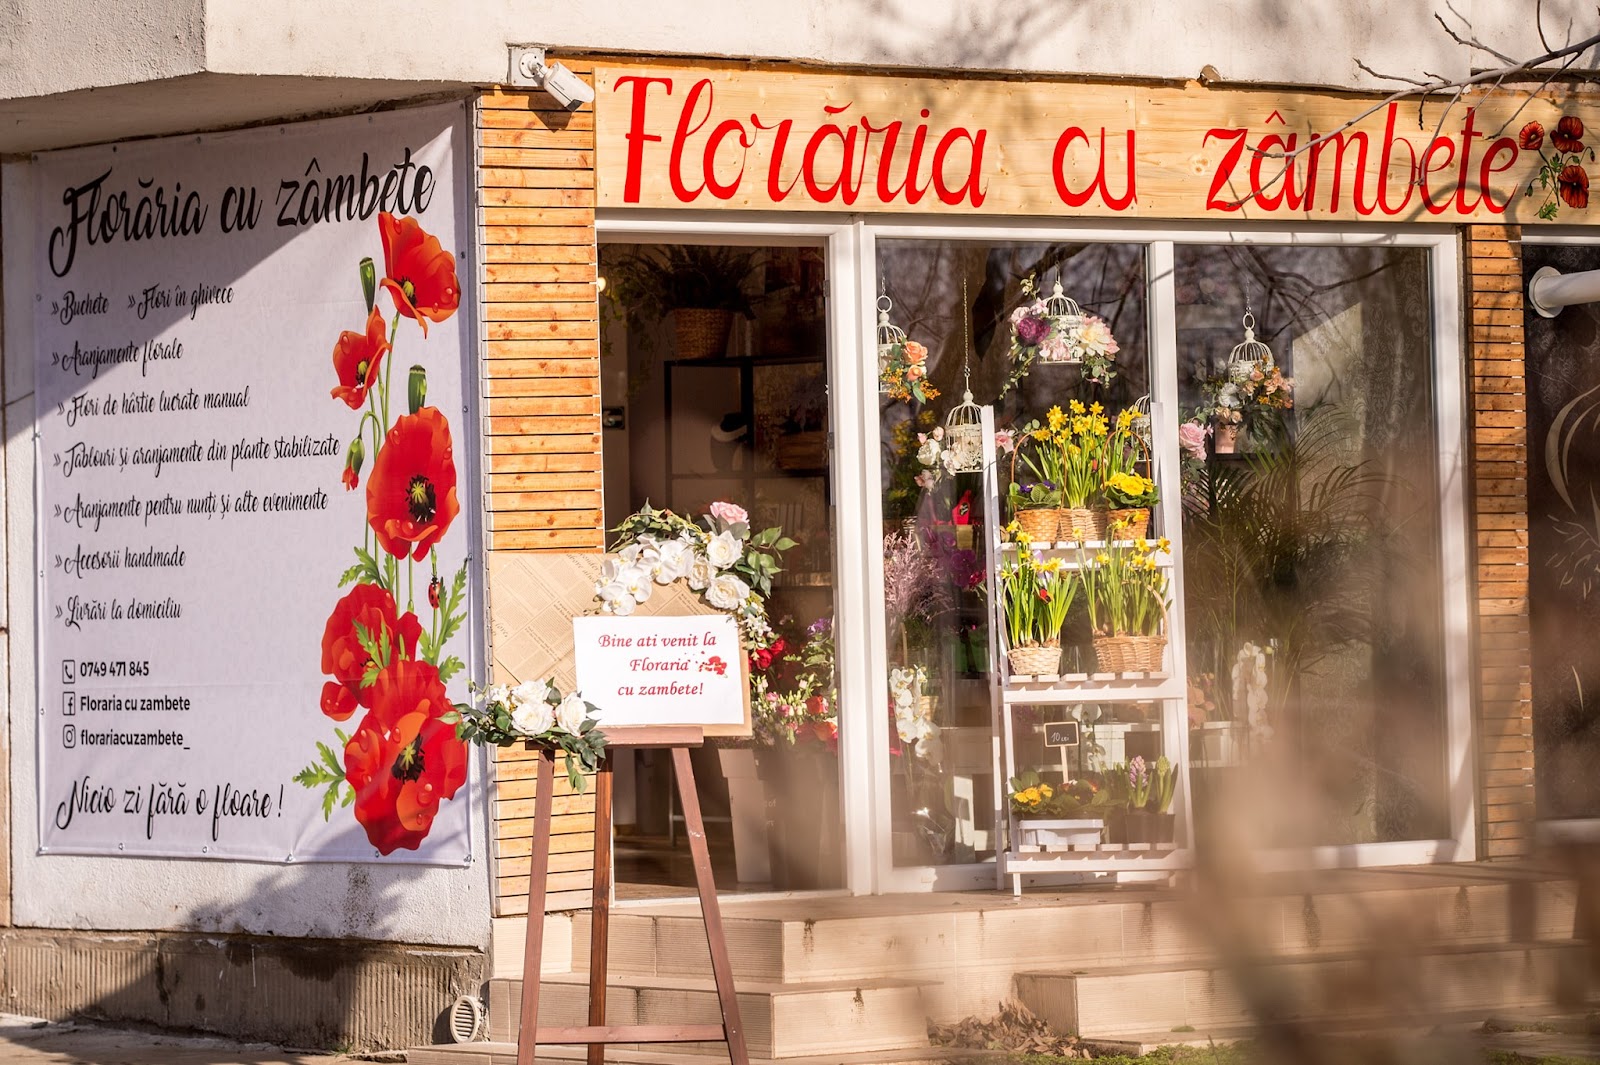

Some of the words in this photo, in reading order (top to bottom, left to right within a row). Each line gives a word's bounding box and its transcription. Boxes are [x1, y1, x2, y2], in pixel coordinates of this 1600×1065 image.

[613, 75, 990, 209] Florăria
[1052, 126, 1137, 211] cu
[1203, 102, 1519, 216] zâmbete
[48, 166, 208, 277] Florăria
[219, 185, 262, 233] cu
[276, 147, 436, 227] zâmbete
[59, 290, 109, 325] Buchete
[137, 283, 172, 320] Flori
[174, 285, 188, 307] în
[190, 286, 234, 320] ghivece
[62, 340, 141, 378] Aranjamente
[143, 337, 184, 376] florale
[67, 392, 100, 427] Flori
[103, 392, 118, 414] de
[121, 390, 156, 414] hârtie
[158, 388, 200, 412] lucrate
[203, 385, 250, 408] manual
[63, 442, 116, 478] Tablouri
[119, 445, 130, 473] și
[132, 440, 204, 478] aranjamente
[206, 437, 227, 461] din
[230, 437, 271, 471] plante
[273, 433, 340, 459] stabilizate
[63, 493, 142, 531] Aranjamente
[144, 492, 184, 526] pentru
[186, 492, 217, 521] nunți
[220, 492, 231, 520] și
[234, 489, 260, 514] alte
[262, 487, 329, 512] evenimente
[64, 544, 121, 579] Accesorii
[124, 545, 186, 568] handmade
[65, 595, 108, 632] Livrări
[111, 597, 124, 620] la
[126, 596, 182, 620] domiciliu
[598, 633, 633, 648] Bine
[636, 634, 658, 647] ati
[661, 633, 699, 647] venit
[702, 631, 717, 646] la
[80, 661, 107, 677] 0749
[109, 661, 127, 677] 471
[129, 661, 149, 676] 845
[629, 657, 689, 672] Floraria
[80, 696, 122, 711] Floraria
[124, 700, 138, 711] cu
[140, 695, 191, 711] zambete
[617, 686, 635, 696] cu
[638, 681, 704, 696] zambete!
[80, 729, 191, 750] florariacuzambete_
[1051, 732, 1060, 742] 10
[56, 776, 117, 830] Nicio
[123, 785, 144, 814] zi
[147, 782, 190, 840] fără
[195, 789, 210, 815] o
